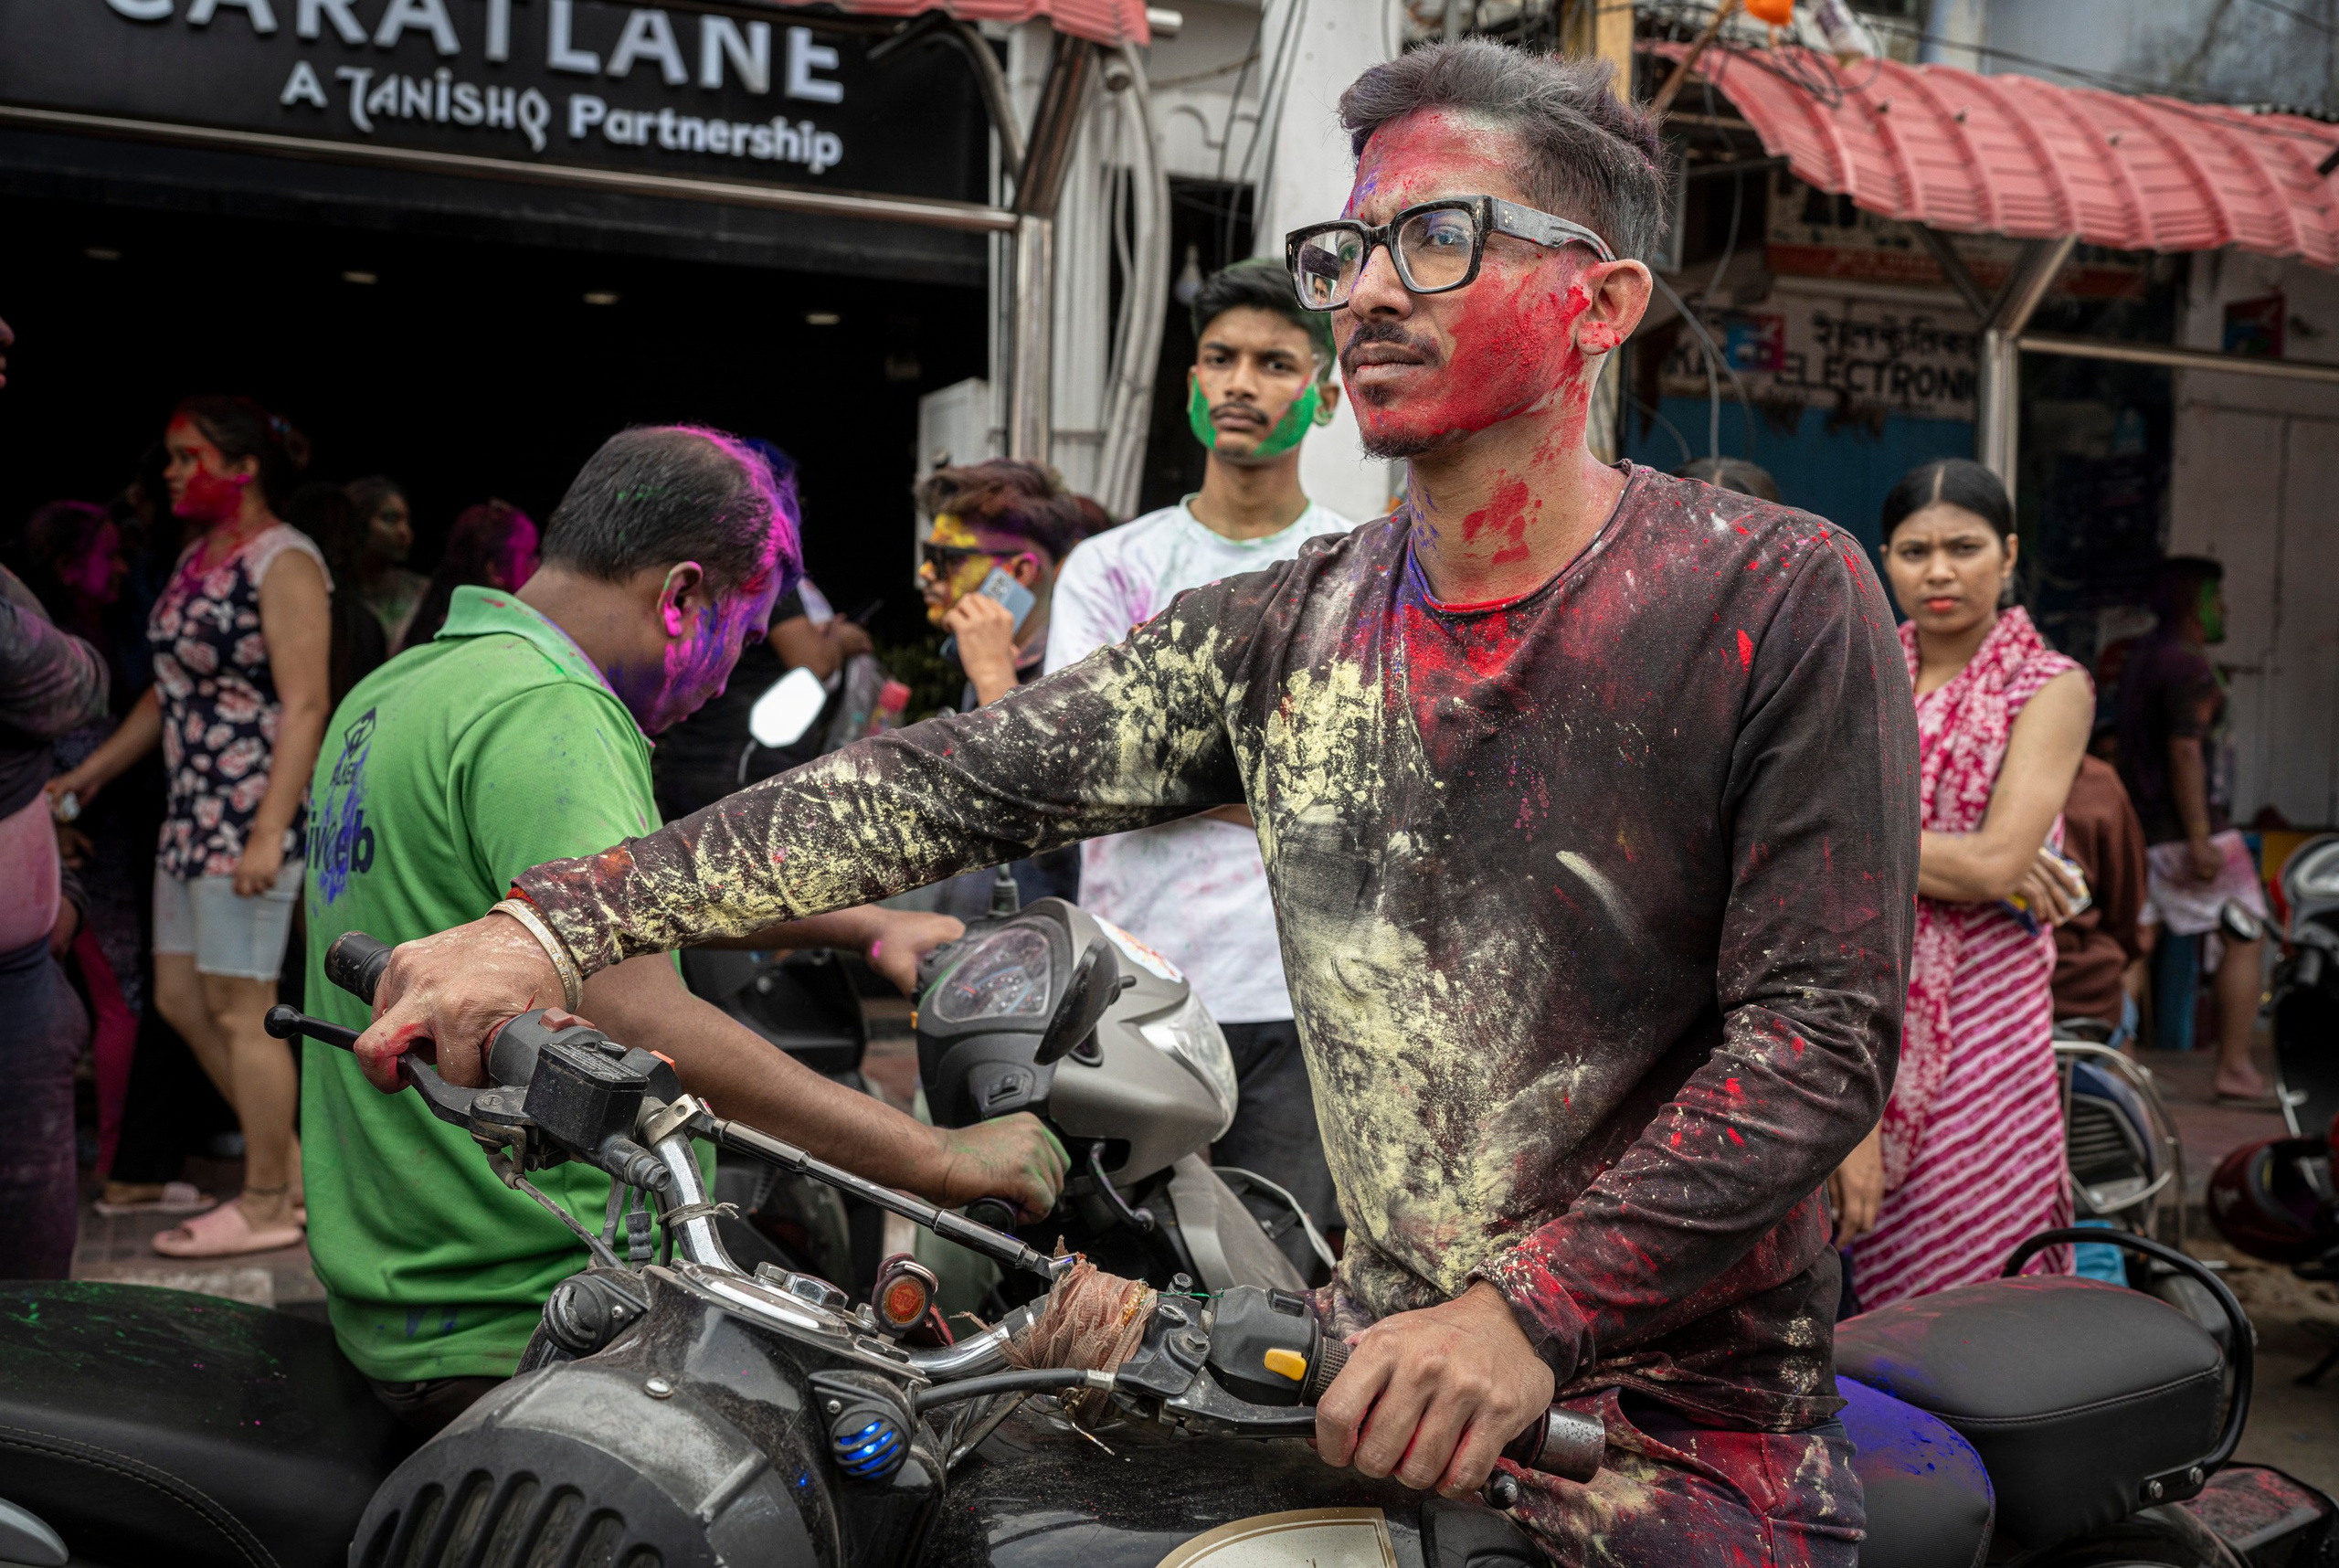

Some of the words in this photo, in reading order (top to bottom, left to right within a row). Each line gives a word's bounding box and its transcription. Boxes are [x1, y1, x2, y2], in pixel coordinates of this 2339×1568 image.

[107, 0, 845, 104] RATLANE
[280, 60, 328, 108] A
[567, 93, 844, 175] Partnership
